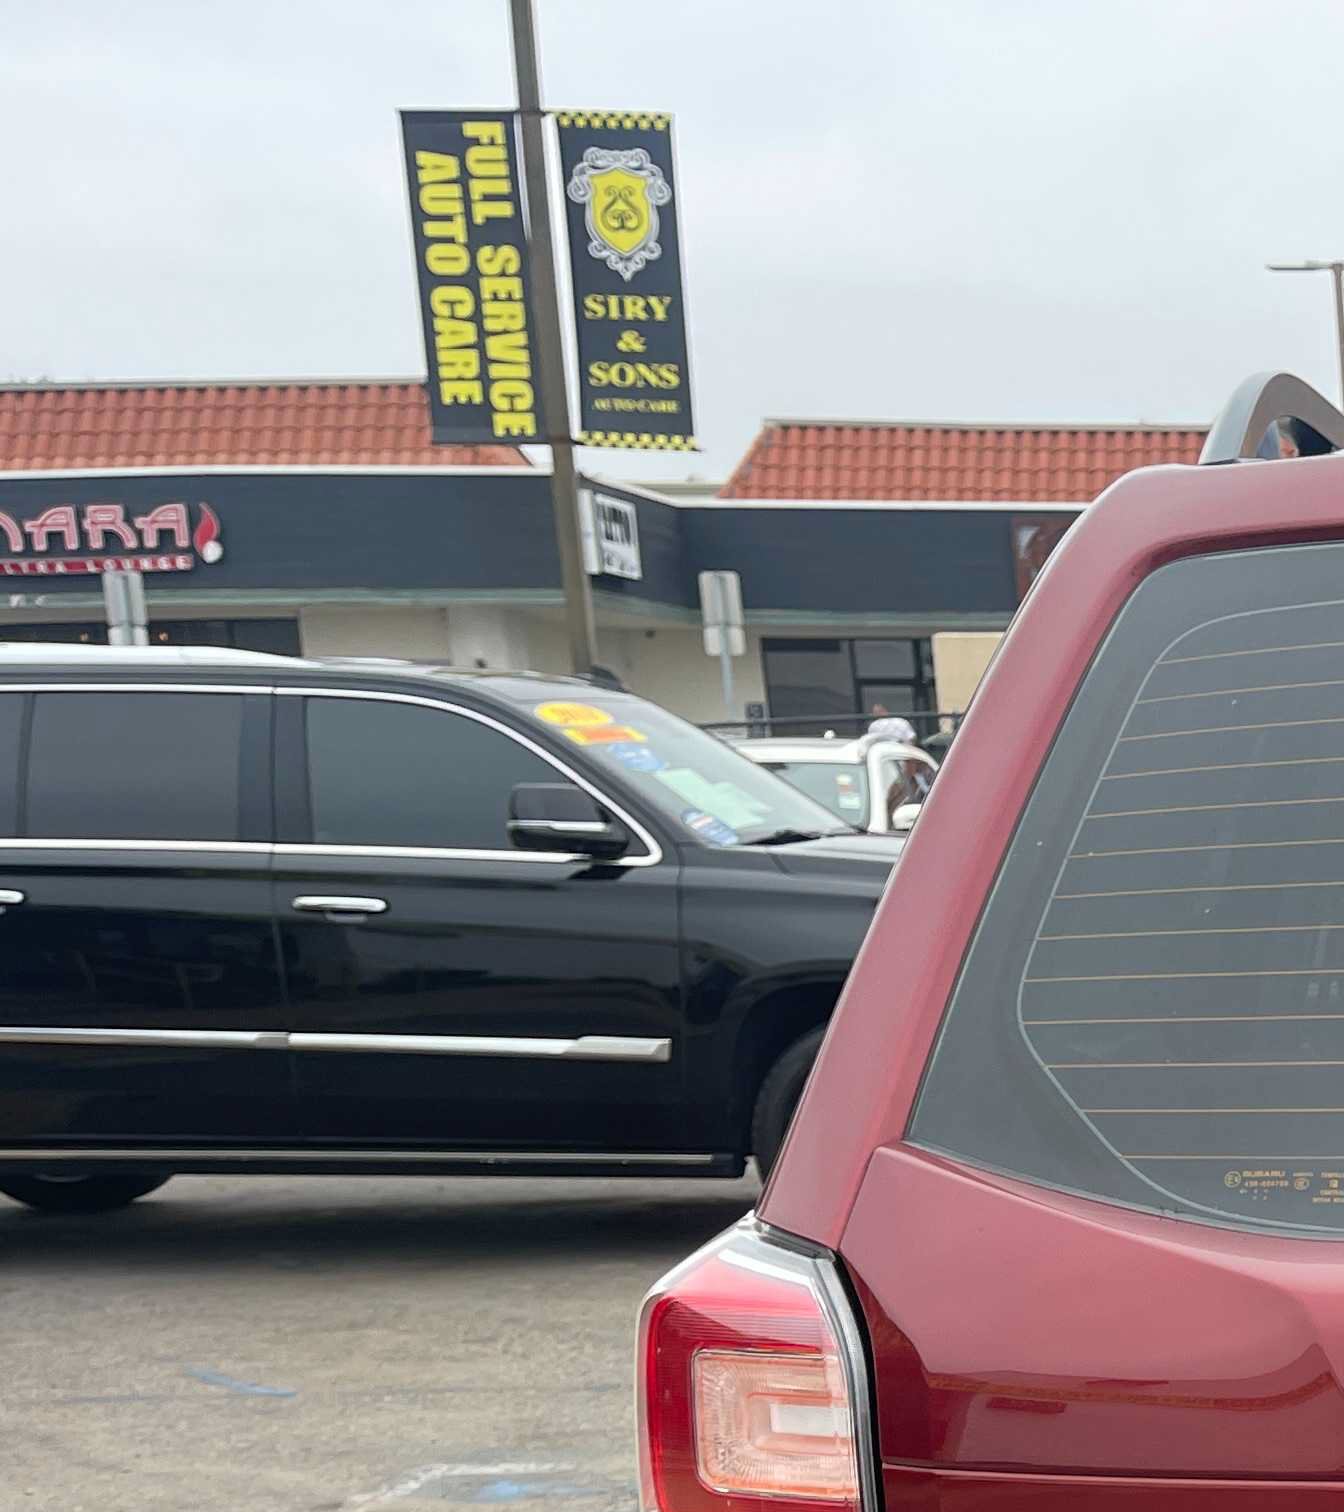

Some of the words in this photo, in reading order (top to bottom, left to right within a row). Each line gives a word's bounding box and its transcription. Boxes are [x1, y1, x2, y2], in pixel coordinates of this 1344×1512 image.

[415, 150, 471, 277] AUTO
[462, 121, 515, 226] FULL
[429, 285, 483, 406] CARE
[476, 244, 537, 438] SERVICE
[583, 294, 673, 322] SIRY
[616, 329, 648, 353] &
[587, 361, 681, 389] SONS
